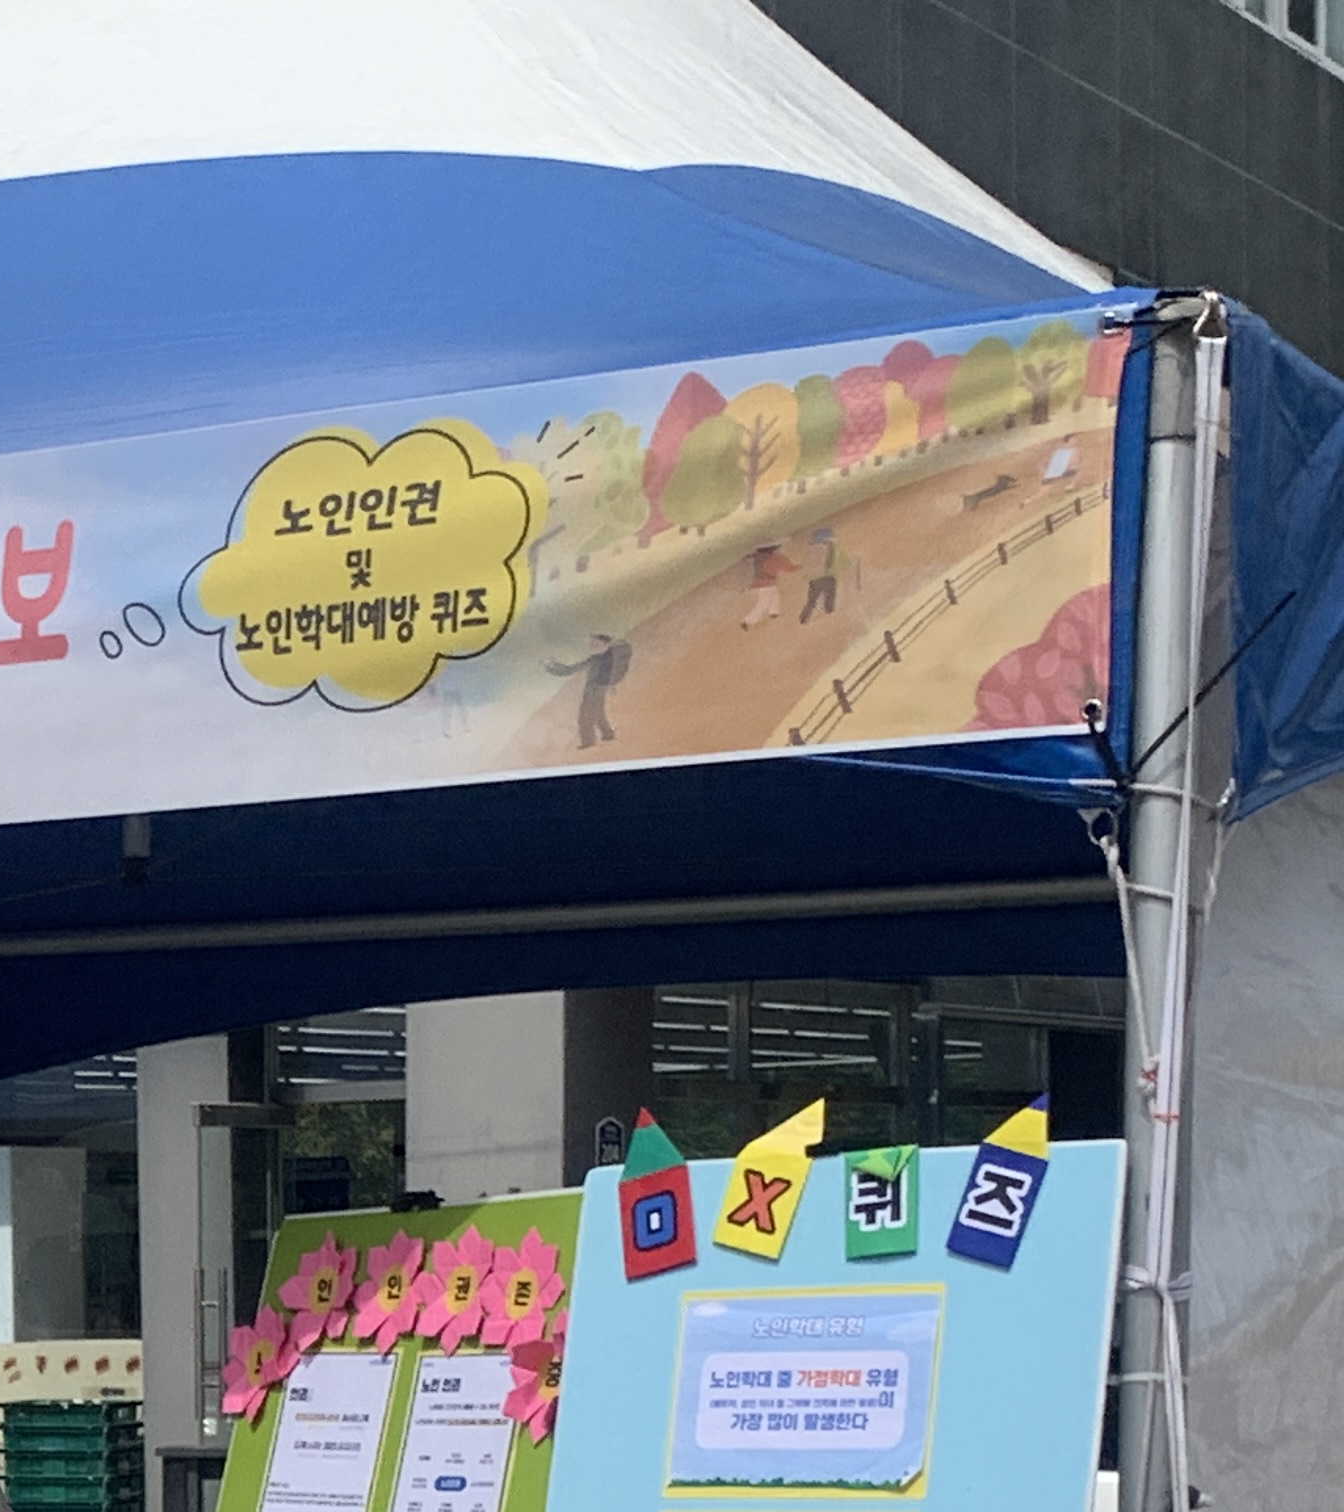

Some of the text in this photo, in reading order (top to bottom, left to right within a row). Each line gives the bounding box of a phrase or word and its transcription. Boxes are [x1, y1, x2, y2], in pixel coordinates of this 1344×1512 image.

[275, 480, 442, 537] 노인인권
[345, 548, 373, 589] 및
[236, 587, 490, 655] 노인학대예방 퀴즈
[709, 1369, 773, 1389] 노인학대
[730, 1412, 763, 1431] 가장
